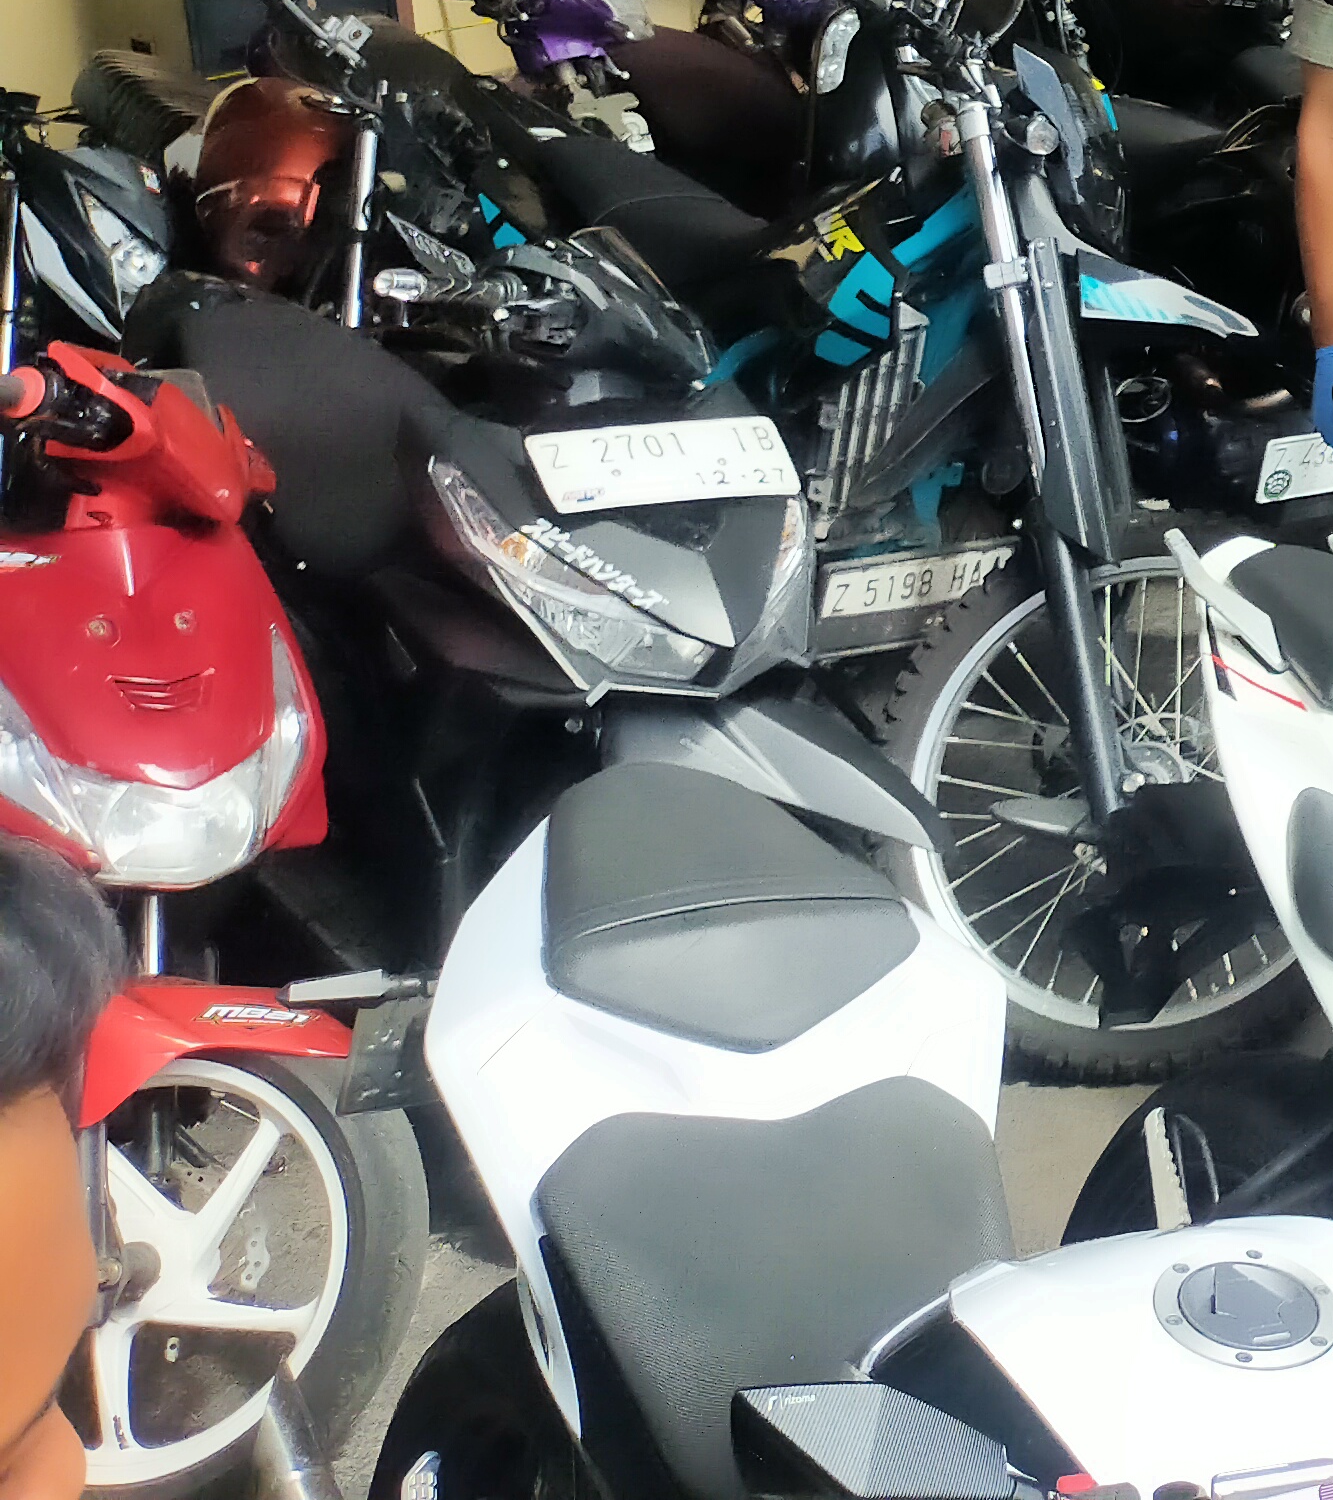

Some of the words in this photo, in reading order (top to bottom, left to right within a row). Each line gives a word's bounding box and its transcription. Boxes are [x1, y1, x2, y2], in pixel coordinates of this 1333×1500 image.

[540, 443, 568, 470] Z
[592, 431, 687, 463] 2701
[833, 582, 850, 614] Z
[864, 568, 933, 605] 5198
